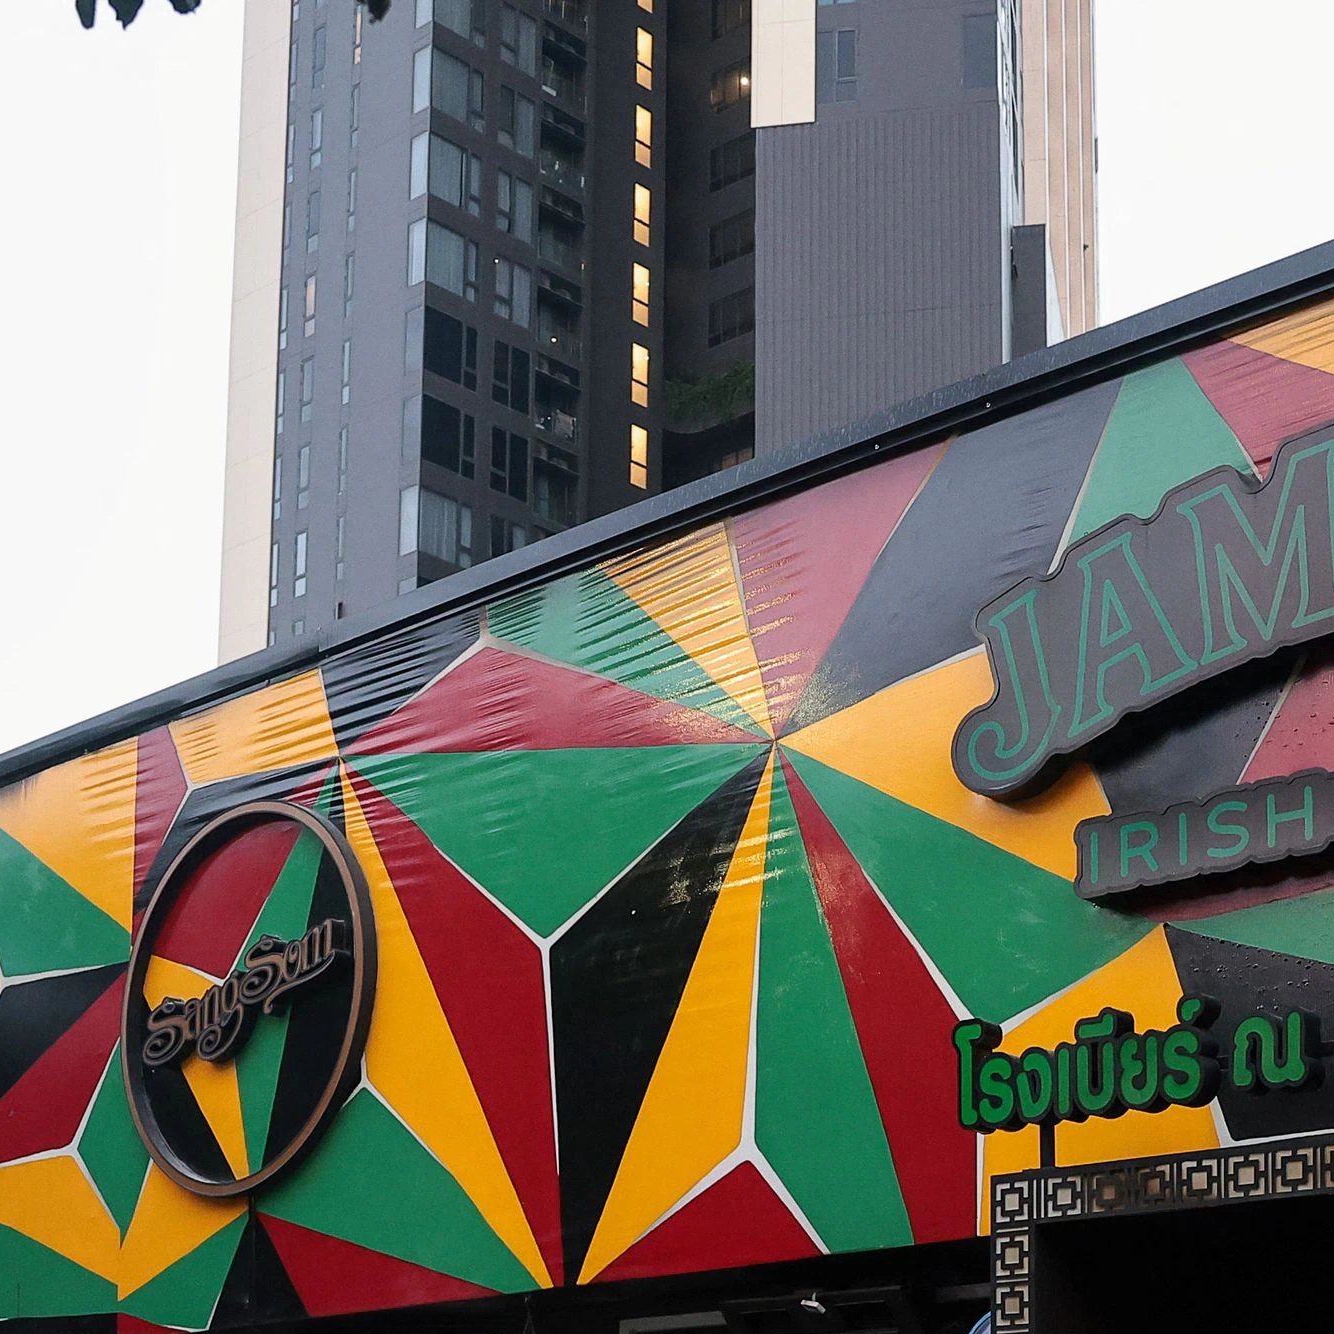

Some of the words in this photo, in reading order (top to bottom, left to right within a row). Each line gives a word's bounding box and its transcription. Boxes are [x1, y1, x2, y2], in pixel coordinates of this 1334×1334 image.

[1088, 799, 1316, 885] IRISH
[959, 998, 1205, 1128] โรงเบียร์
[1230, 1010, 1308, 1088] ณ
